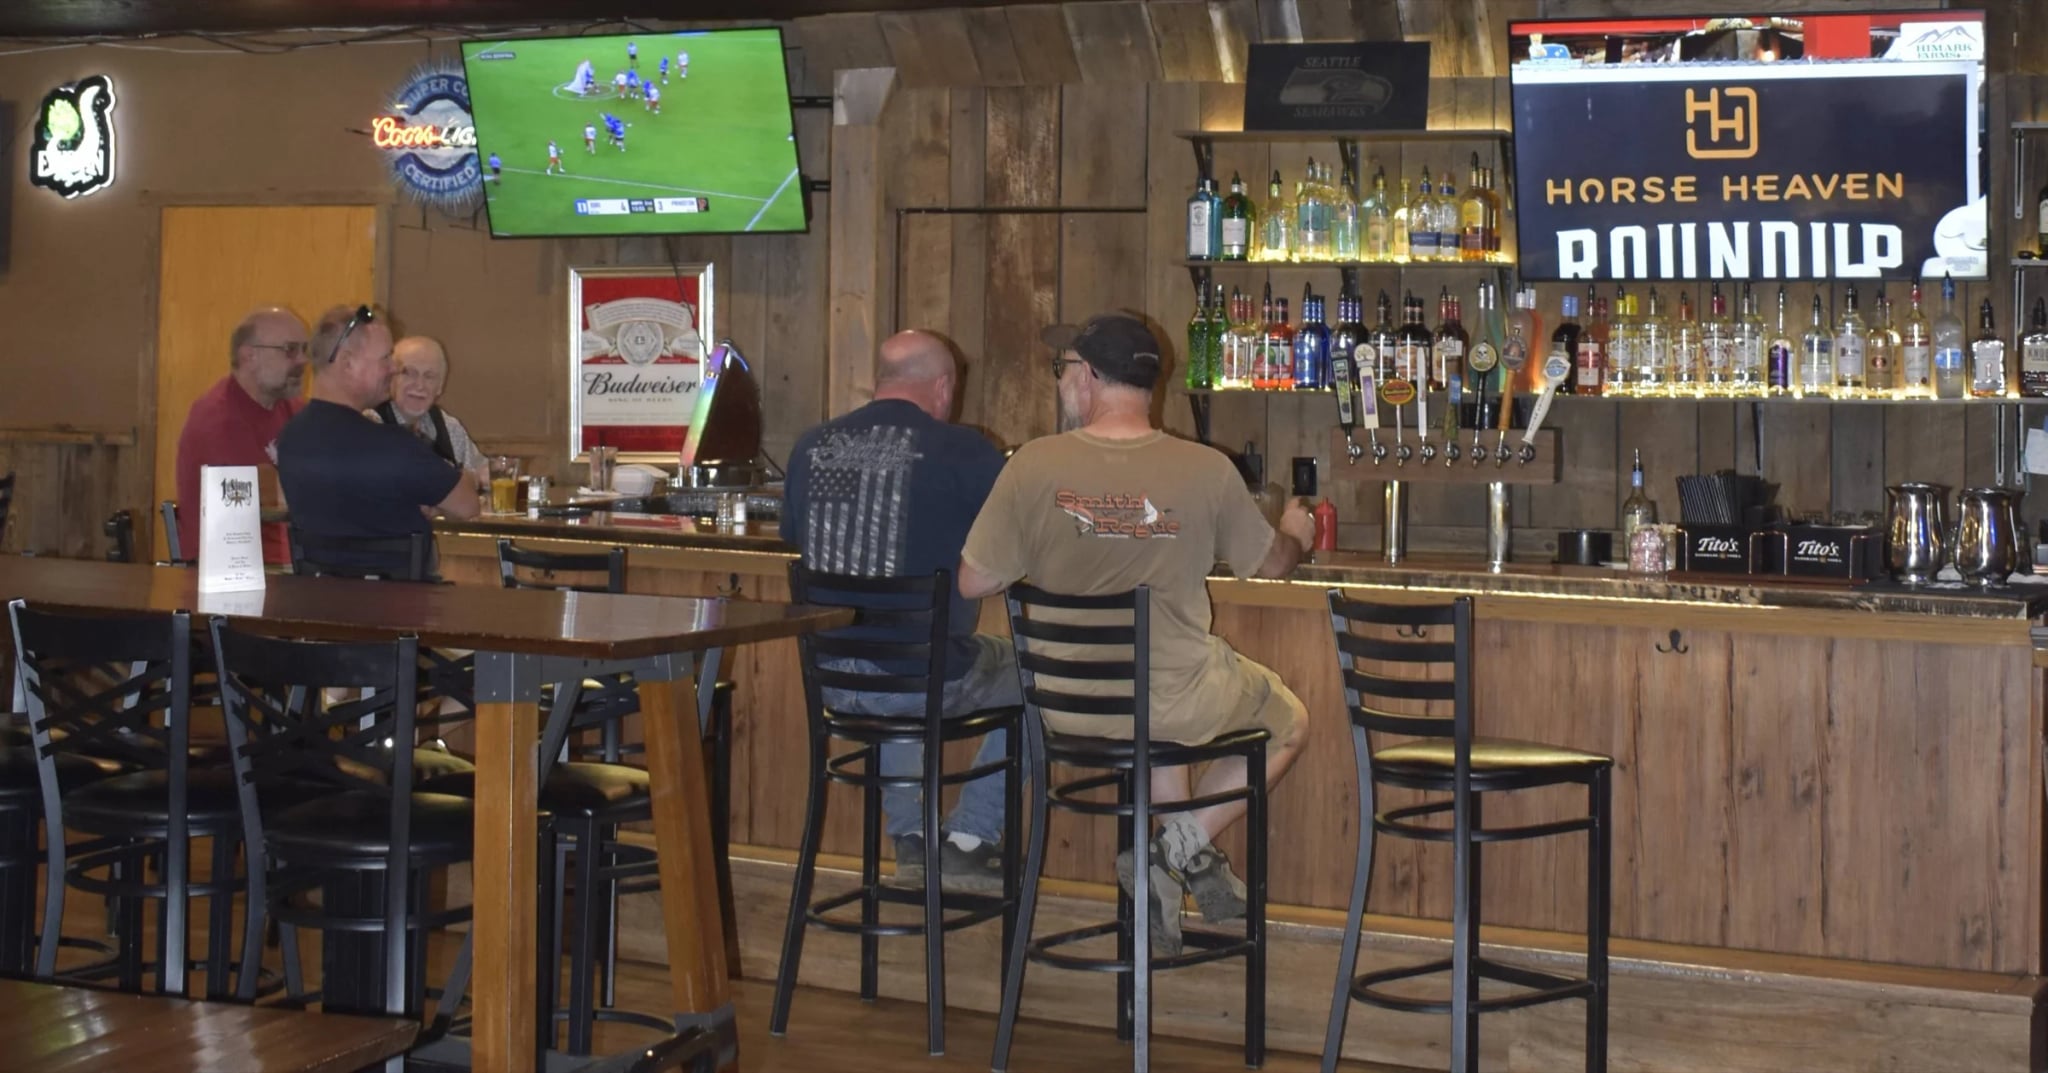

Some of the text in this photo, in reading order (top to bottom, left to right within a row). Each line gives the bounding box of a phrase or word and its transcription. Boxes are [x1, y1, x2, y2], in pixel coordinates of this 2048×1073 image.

[1304, 56, 1361, 67] SEATTLE
[372, 117, 438, 147] Coors
[404, 163, 476, 190] CERTIFIED
[1546, 172, 1903, 205] HORSE HEAVEN
[582, 371, 697, 396] Budweiser
[1055, 490, 1145, 508] Smith
[1697, 536, 1739, 553] Tito's
[1797, 540, 1840, 557] Tito's
